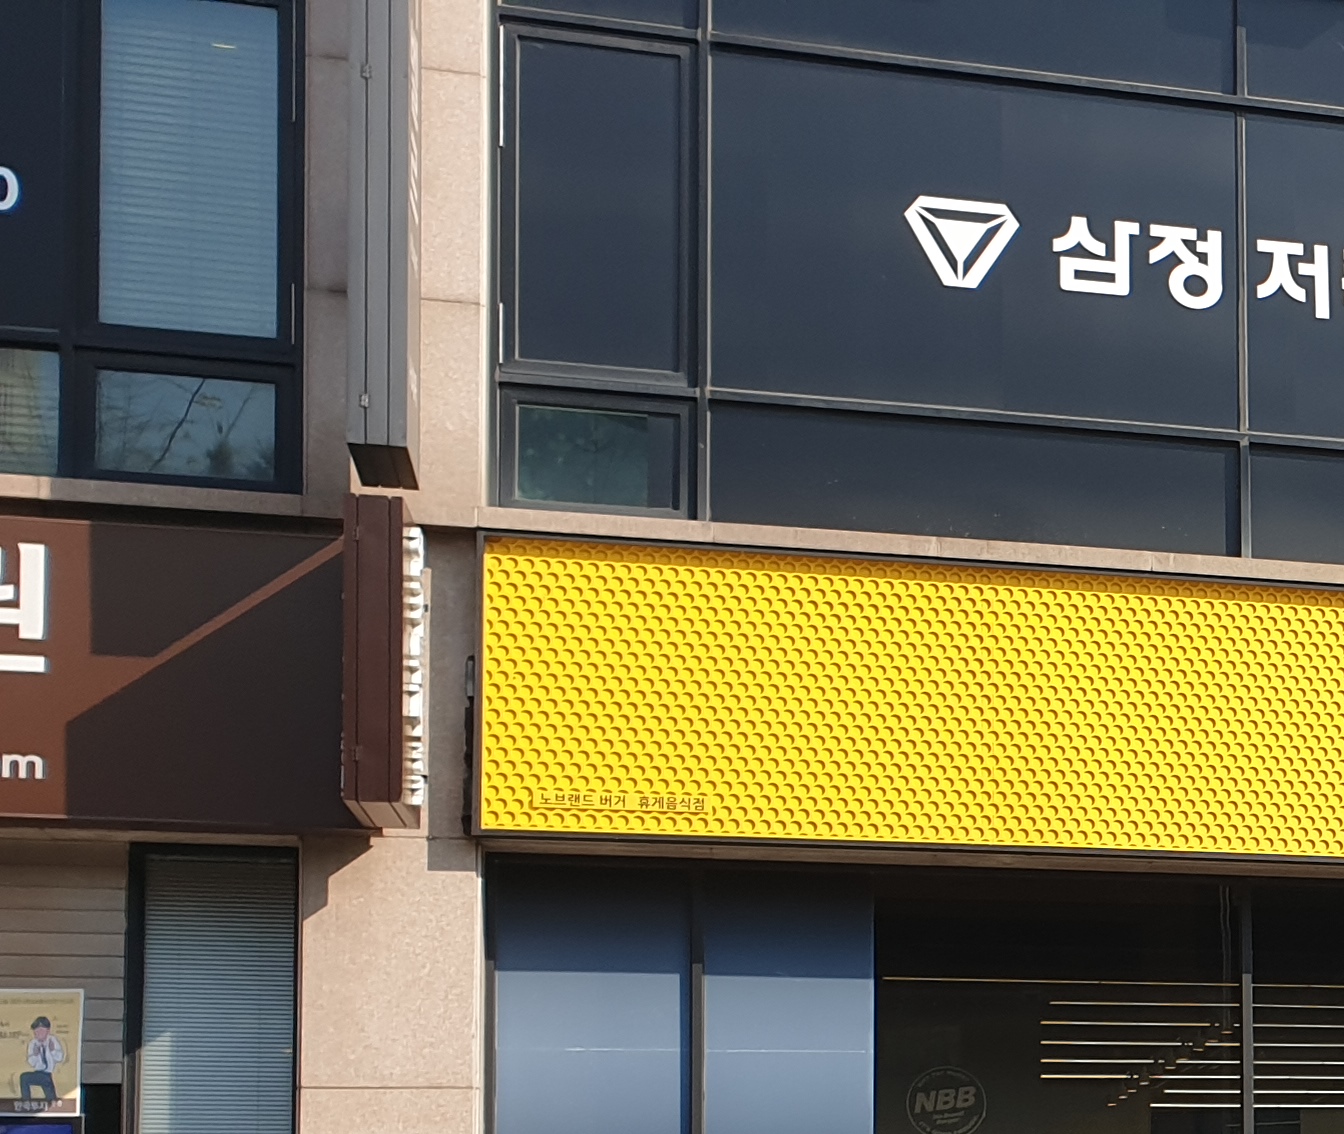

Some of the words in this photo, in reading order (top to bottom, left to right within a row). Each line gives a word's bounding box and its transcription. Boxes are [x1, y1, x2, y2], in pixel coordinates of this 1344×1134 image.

[1051, 214, 1224, 311] 삼정
[539, 793, 595, 807] 노브랜드
[599, 795, 626, 808] 버거
[637, 795, 706, 811] 휴게음식점
[914, 1086, 977, 1113] NBB
